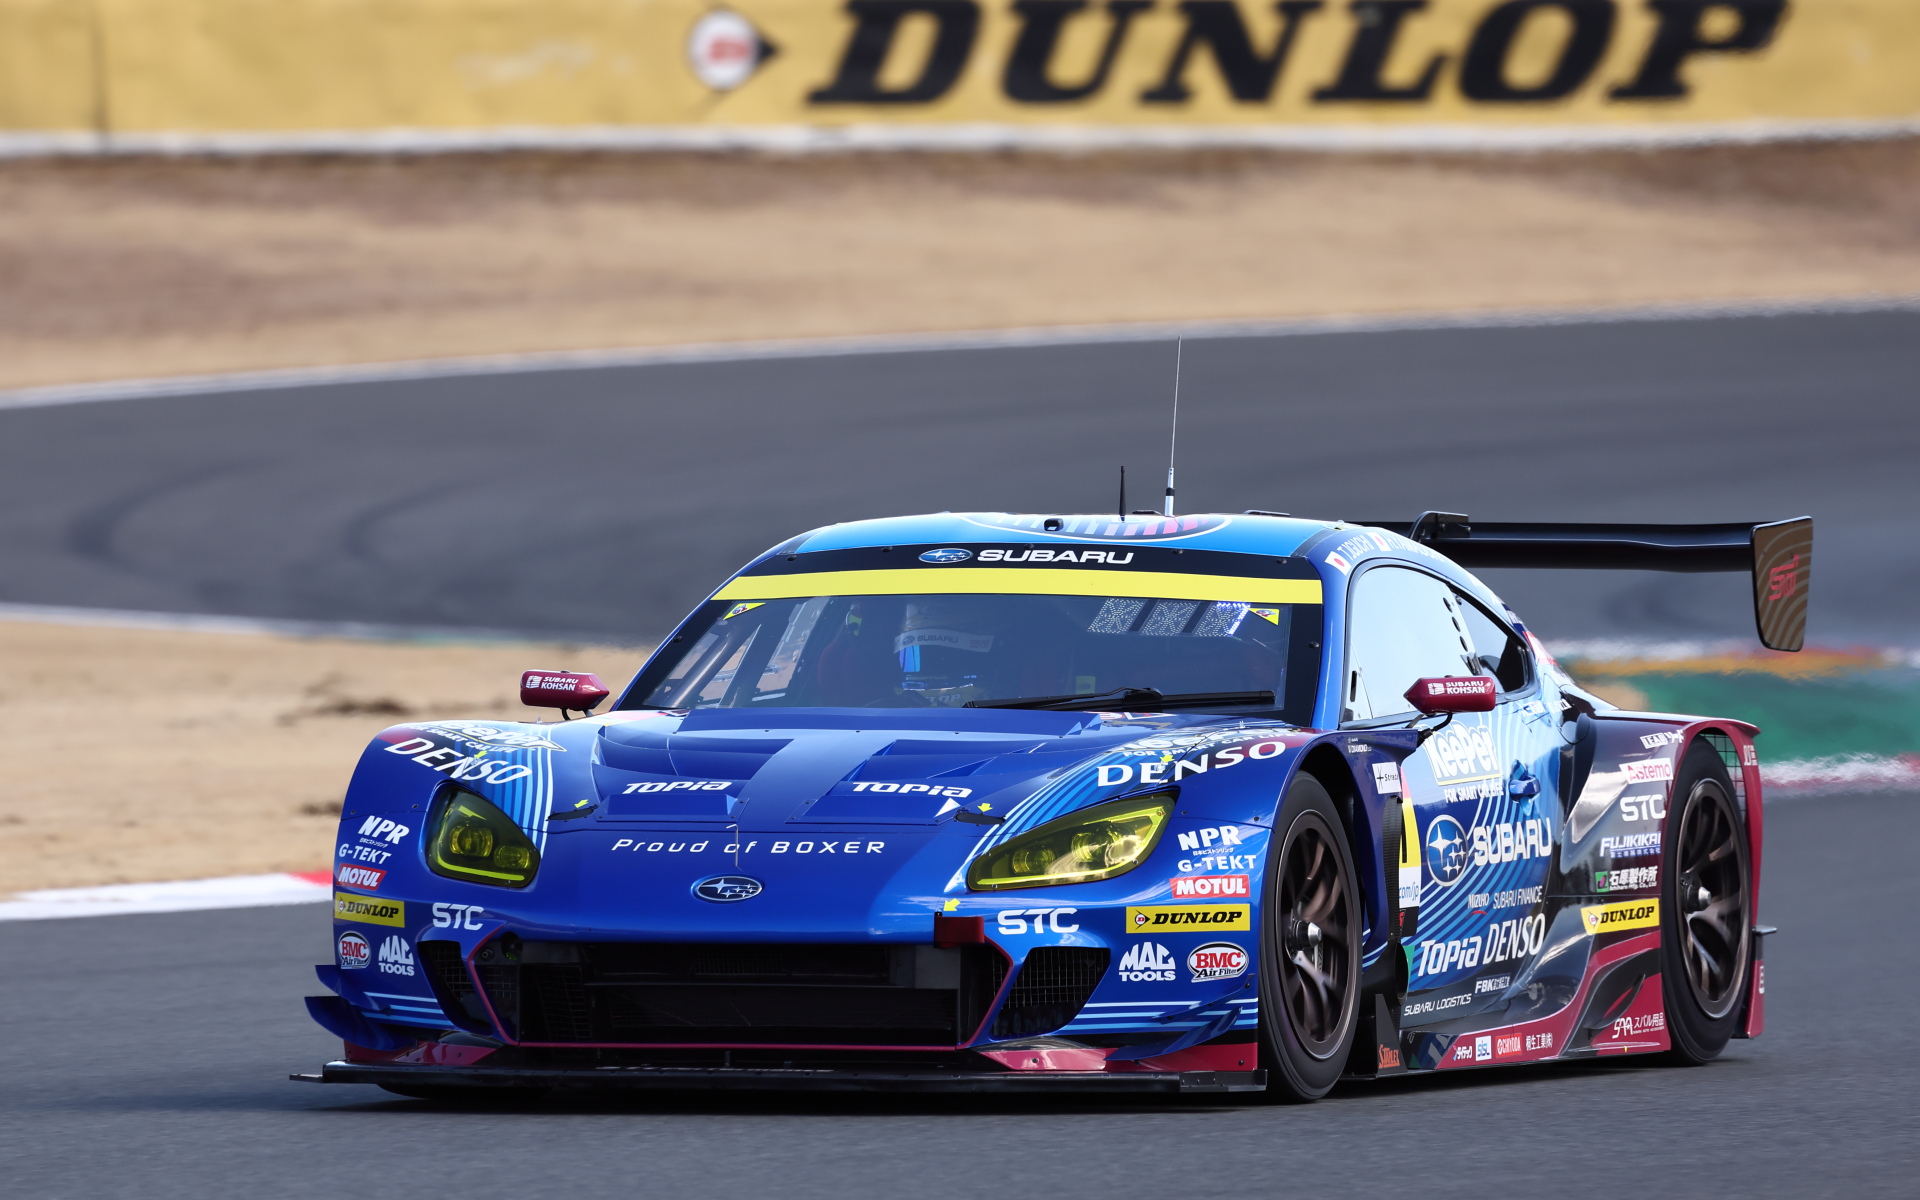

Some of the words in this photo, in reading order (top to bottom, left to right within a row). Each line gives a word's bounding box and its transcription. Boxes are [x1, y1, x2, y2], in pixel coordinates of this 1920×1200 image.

[806, 0, 1795, 104] DUNLOP
[977, 549, 1135, 565] SUBARU
[916, 634, 959, 644] SUBARU
[541, 682, 576, 691] KOHSAN
[543, 676, 579, 684] SUBARU
[1446, 686, 1485, 694] KOHSAN
[465, 741, 490, 750] CAR
[1221, 736, 1253, 744] CAR
[384, 737, 532, 785] DENSO
[1096, 741, 1286, 787] DENSO
[1627, 763, 1671, 781] Astemo
[1443, 788, 1459, 803] FOR
[1620, 794, 1667, 822] STC
[358, 815, 410, 844] NPR
[1177, 825, 1242, 851] NPR
[611, 839, 709, 853] Proud
[723, 841, 758, 853] of
[770, 841, 885, 854] BOXER
[1473, 817, 1552, 867] SUBARU
[1600, 831, 1661, 857] FUJIKIKAI
[338, 843, 392, 865] G-TEKT
[1177, 855, 1257, 872] G-TEKT
[338, 866, 381, 887] MOTUL
[1609, 865, 1658, 886] 石原製作所
[1175, 878, 1247, 895] MOTUL
[1467, 892, 1490, 909] MIZUHO
[1493, 889, 1518, 909] SUBARU
[1517, 885, 1543, 906] FINANCE
[346, 901, 399, 919] DUNLOP
[432, 903, 484, 931] STC
[1151, 911, 1243, 925] DUNLOP
[1600, 906, 1655, 924] DUNLOP
[998, 907, 1080, 935] STC
[1482, 913, 1546, 965] DENSO
[341, 940, 368, 959] BMC
[378, 935, 415, 965] MAC
[1119, 941, 1176, 971] MAC
[1195, 952, 1242, 969] BMC
[378, 963, 415, 977] TOOLS
[1119, 971, 1176, 982] TOOLS
[1196, 967, 1218, 979] Air
[1218, 967, 1238, 976] Filter
[1475, 979, 1494, 994] FBK
[1404, 1001, 1435, 1016] SUBARU
[1436, 994, 1472, 1011] LOGISTICS
[1634, 1012, 1664, 1029] スバル用品
